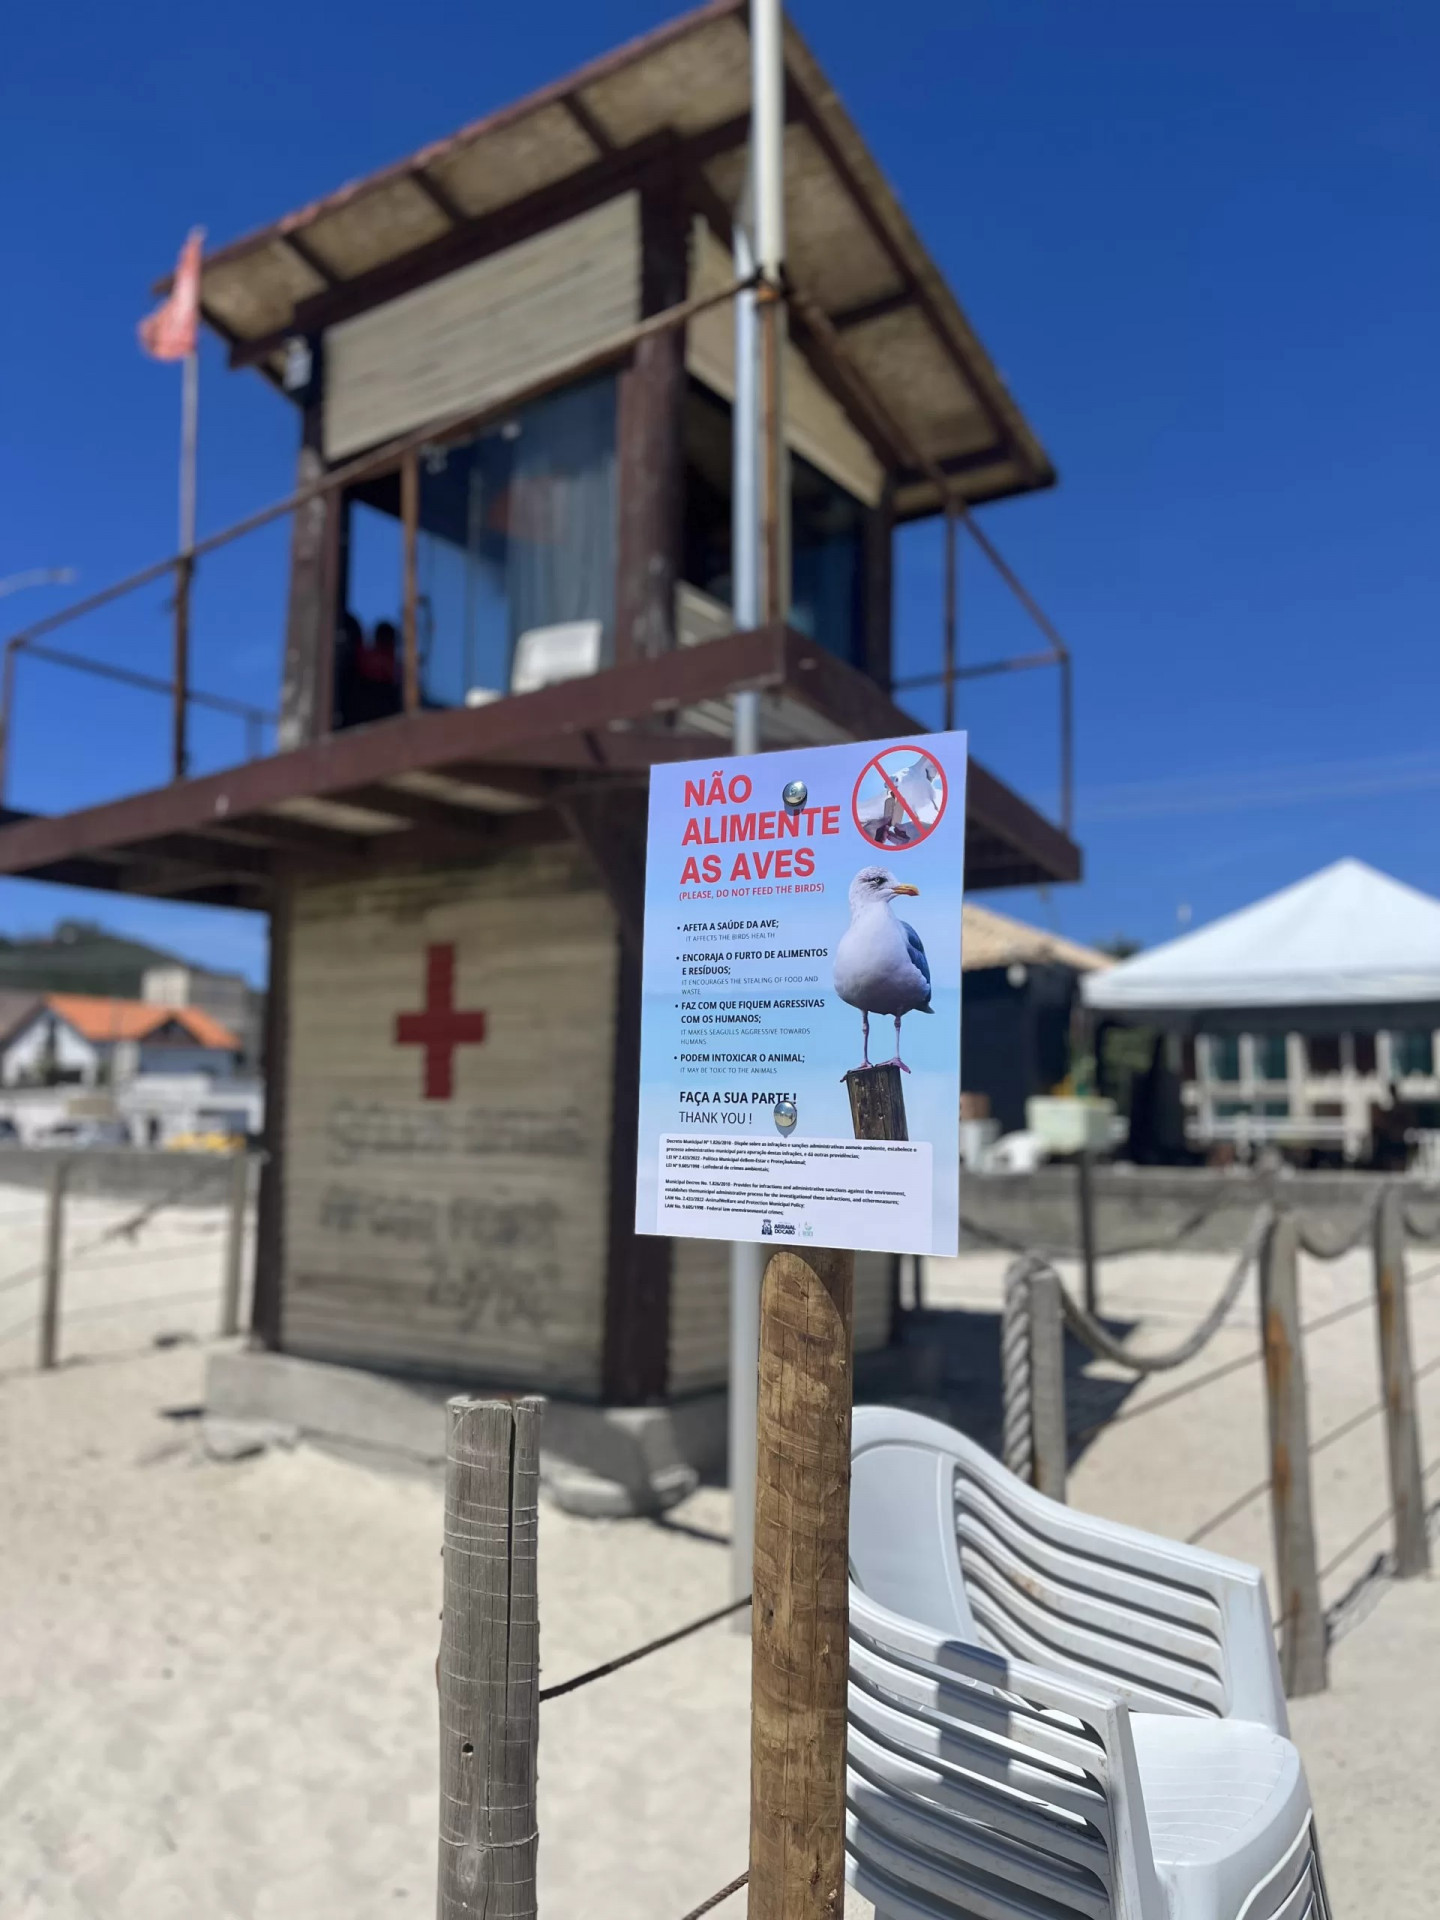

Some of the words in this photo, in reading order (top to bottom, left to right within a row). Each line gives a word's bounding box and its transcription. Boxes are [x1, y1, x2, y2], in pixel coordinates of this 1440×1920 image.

[685, 770, 752, 807] NÃO
[682, 805, 840, 846] ALIMENTE
[680, 855, 722, 884] AS
[730, 848, 815, 881] AVES
[679, 888, 714, 901] (PLEASE,
[716, 887, 729, 898] DO
[731, 887, 750, 897] NOT
[752, 886, 773, 896] FEED
[776, 885, 793, 894] THE
[795, 883, 824, 894] BIRDS)
[683, 923, 708, 932] AFETA
[717, 920, 744, 930] SAÚDE
[747, 921, 759, 929] DA
[760, 919, 779, 929] AVE;
[682, 953, 724, 962] ENCORAJA
[726, 952, 732, 960] O
[735, 951, 762, 960] FURTO
[764, 951, 775, 959] DE
[777, 948, 828, 958] ALIMENTOS
[688, 965, 731, 975] RESÍDUOS;
[681, 1002, 696, 1010] FAZ
[698, 1001, 717, 1010] COM
[719, 1001, 736, 1011] QUE
[739, 1000, 771, 1010] FIQUEM
[773, 999, 825, 1009] AGRESSIVAS
[681, 1015, 700, 1024] COM
[702, 1015, 714, 1023] OS
[715, 1014, 761, 1024] HUMANOS;
[680, 1054, 710, 1062] PODEM
[712, 1054, 757, 1062] INTOXICAR
[759, 1054, 766, 1062] O
[768, 1054, 805, 1063] ANIMAL;
[680, 1091, 710, 1106] FAÇA
[712, 1093, 721, 1103] A
[724, 1092, 748, 1104] SUA
[679, 1111, 718, 1124] THANK
[720, 1112, 746, 1124] YOU
